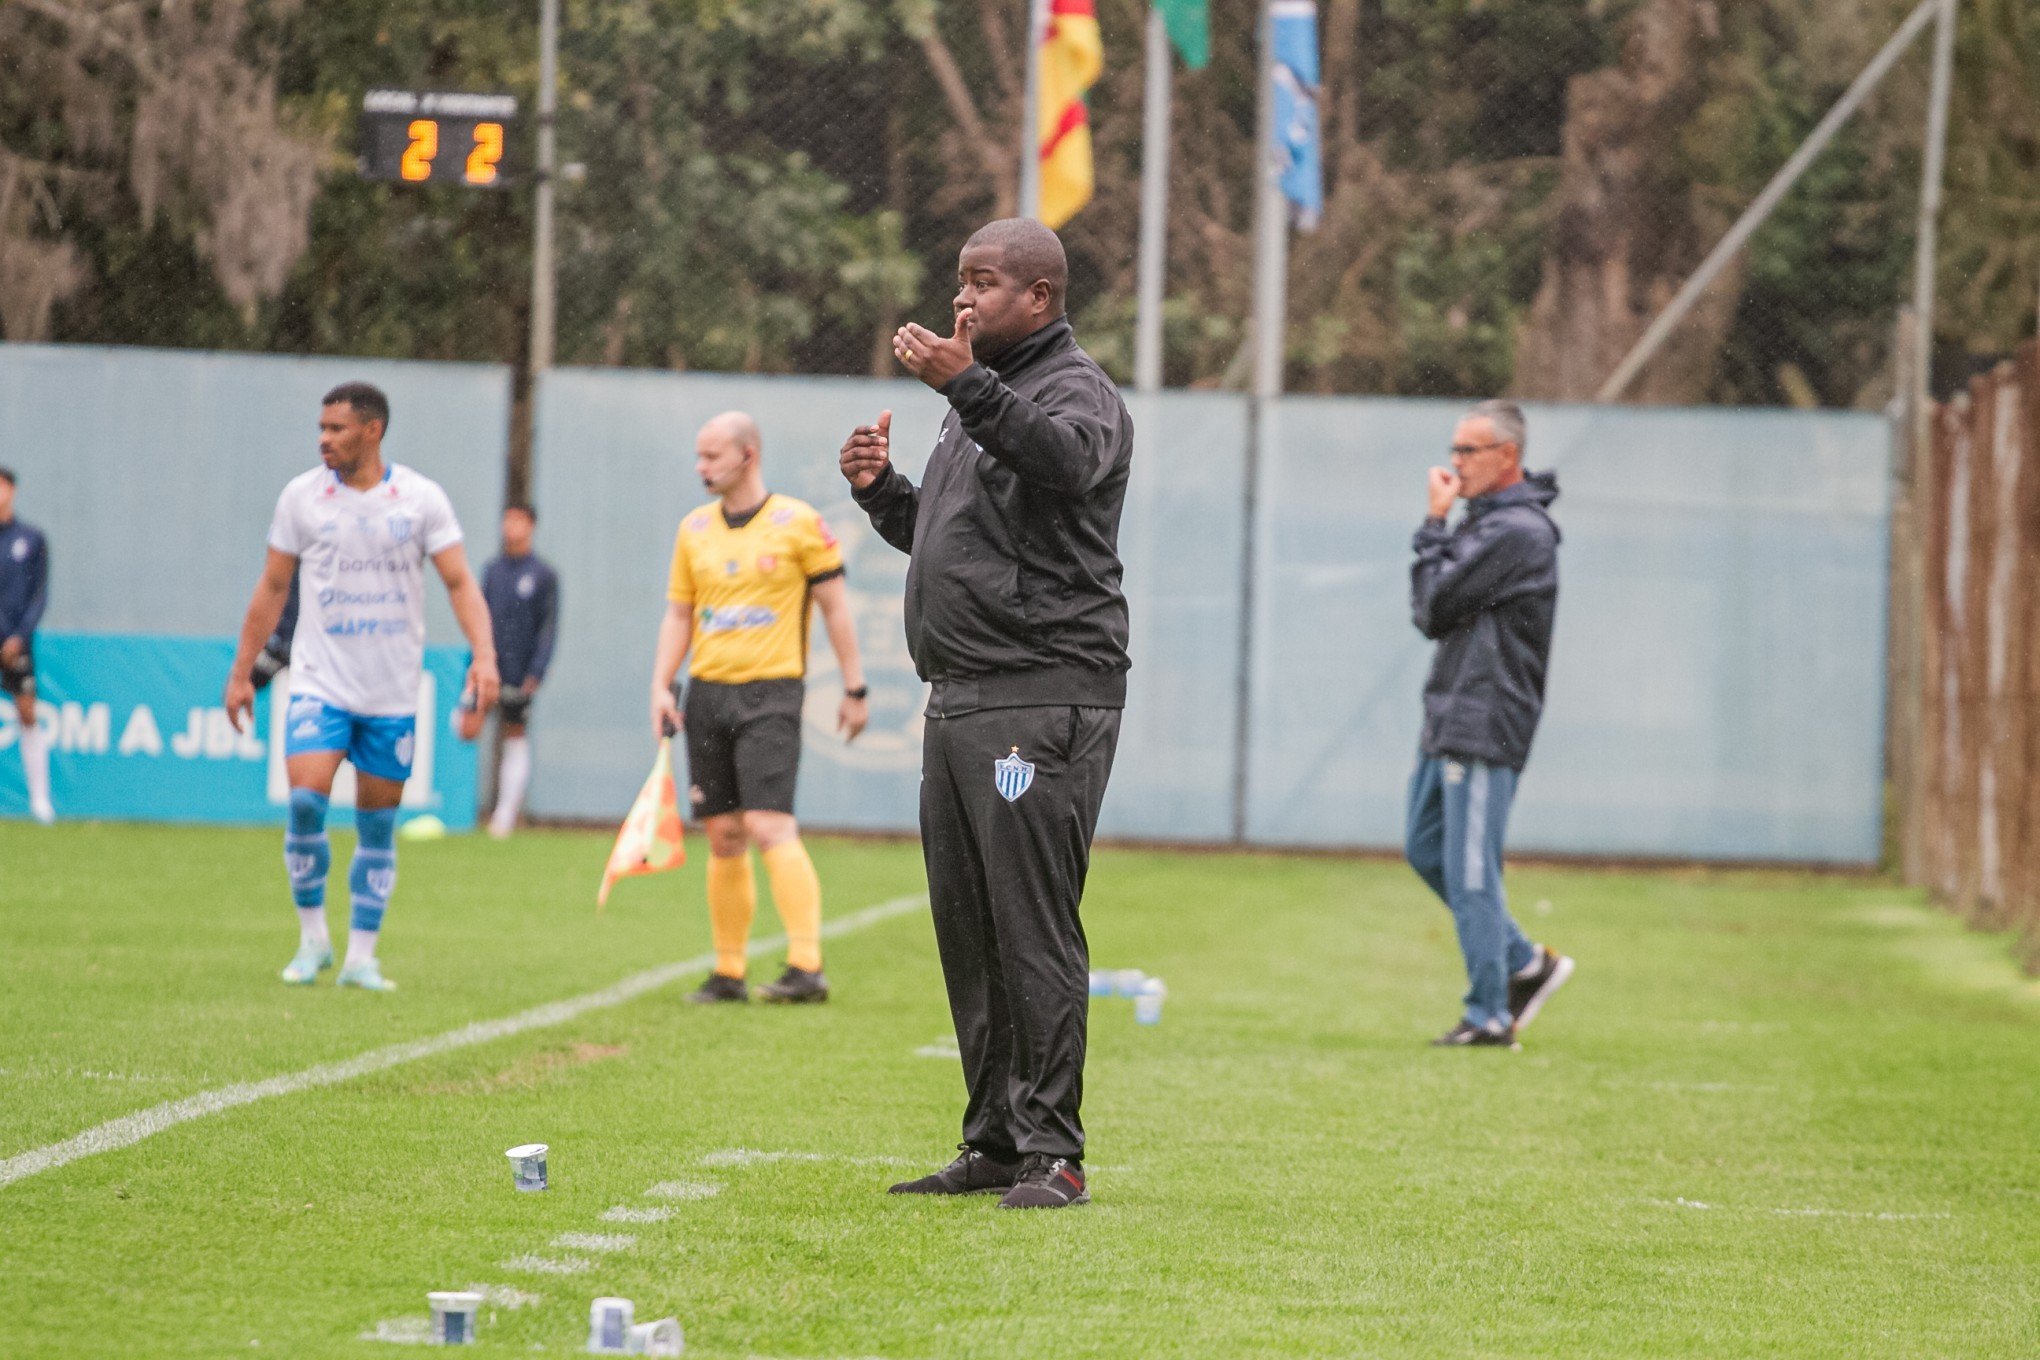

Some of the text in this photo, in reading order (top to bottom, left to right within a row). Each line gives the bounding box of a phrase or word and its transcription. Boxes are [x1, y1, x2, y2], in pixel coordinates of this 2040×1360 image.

[402, 120, 503, 184] 2 2
[118, 704, 163, 756] A
[172, 707, 266, 760] JBL
